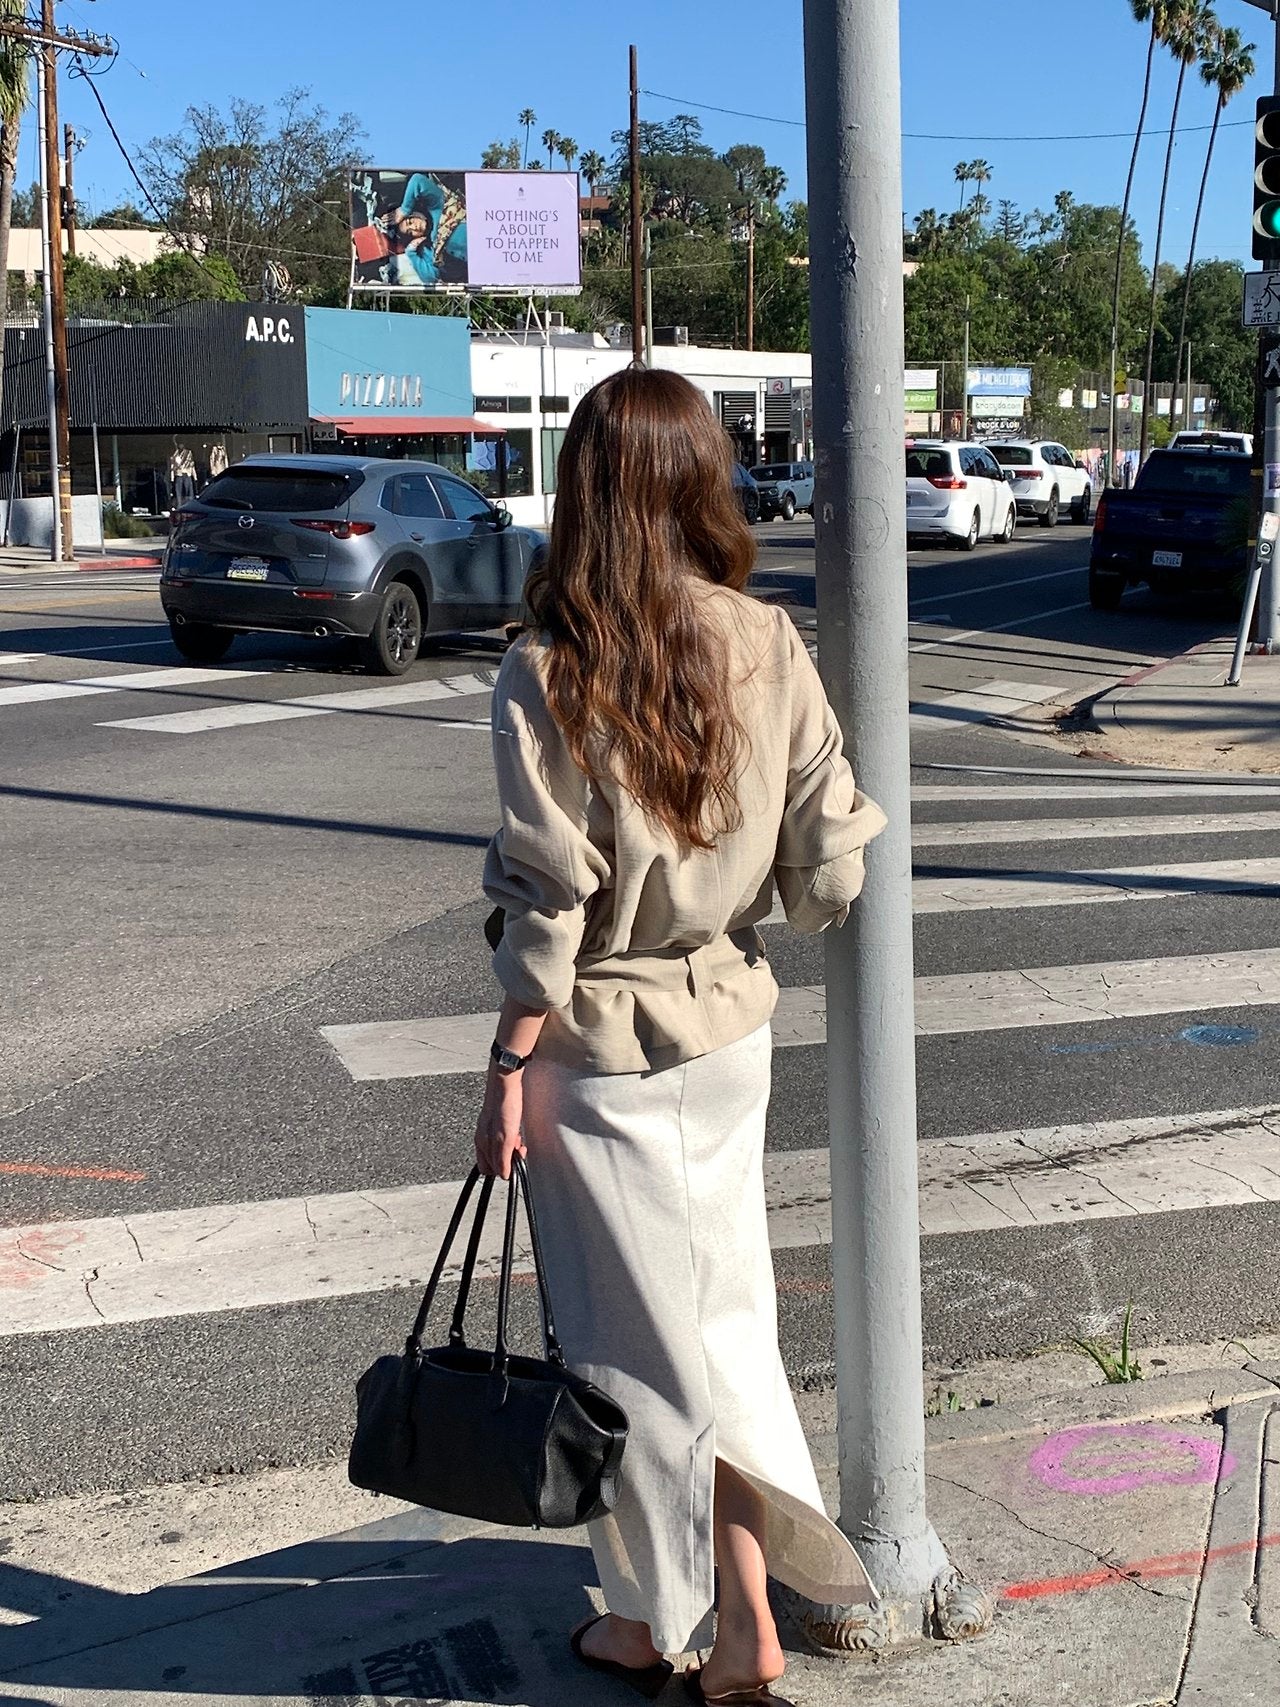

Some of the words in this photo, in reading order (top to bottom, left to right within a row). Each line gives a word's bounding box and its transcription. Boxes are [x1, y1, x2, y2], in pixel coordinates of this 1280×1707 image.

[485, 210, 559, 222] NOTHING'S
[498, 224, 546, 235] ABOUT
[486, 238, 504, 249] TO
[508, 238, 559, 249] HAPPEN
[502, 251, 521, 262] TO
[524, 251, 544, 263] ME
[245, 316, 294, 343] A.P.C.
[341, 372, 423, 407] PIZZANA
[313, 431, 335, 439] A.P.C.
